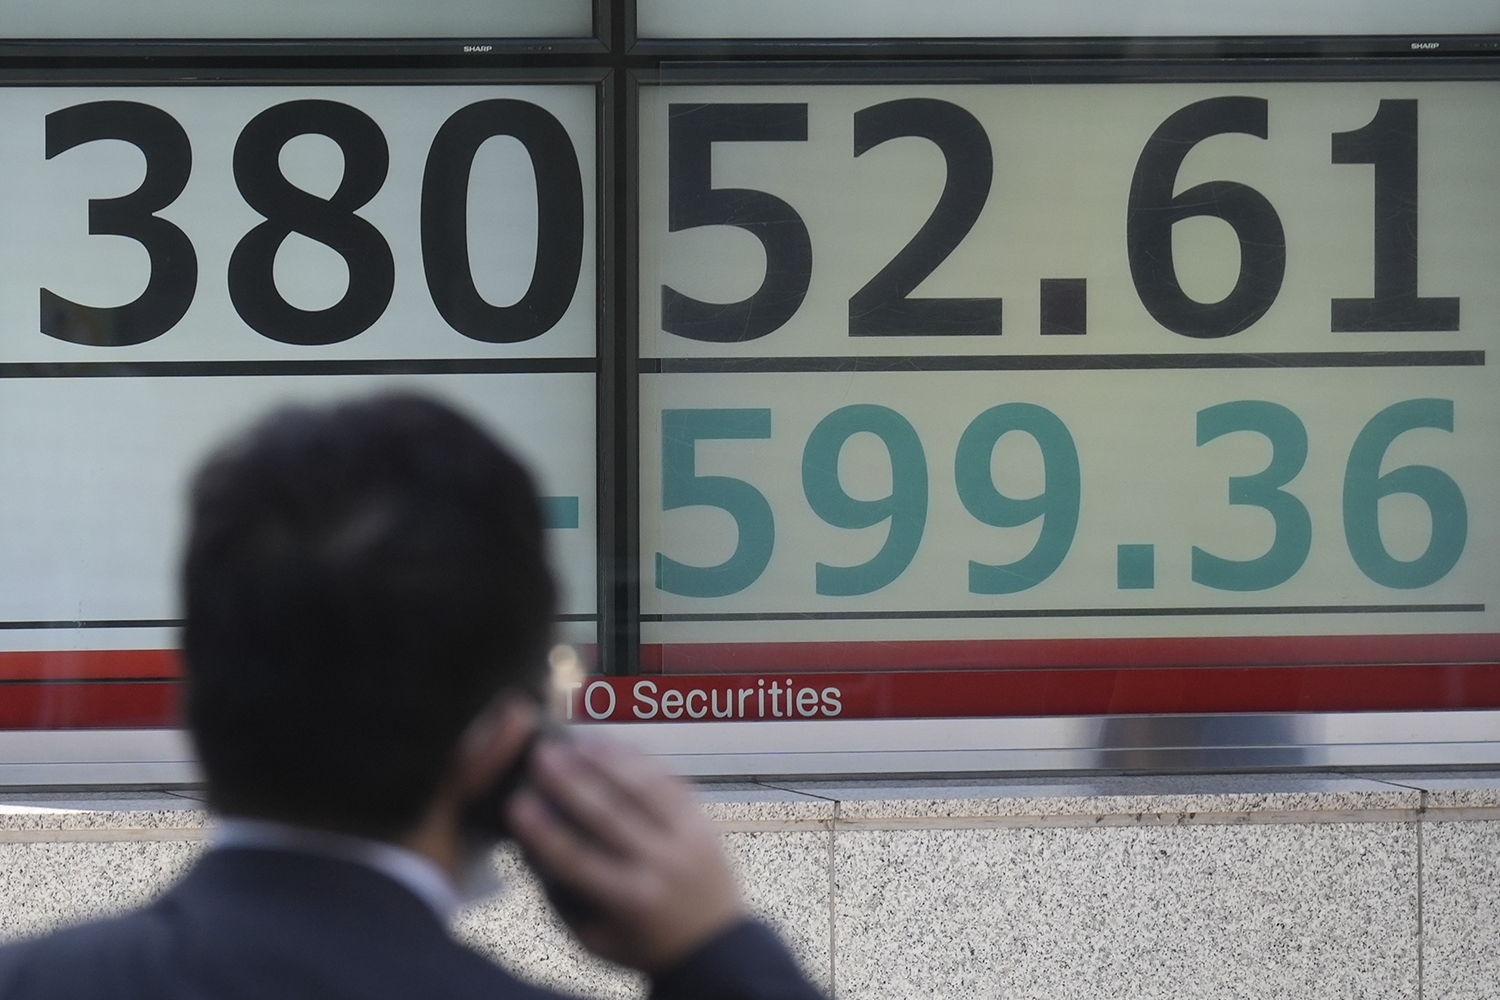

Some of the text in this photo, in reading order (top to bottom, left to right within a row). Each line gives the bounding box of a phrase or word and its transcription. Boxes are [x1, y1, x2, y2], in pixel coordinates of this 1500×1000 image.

[463, 45, 493, 53] SHARP
[1411, 42, 1440, 50] SHARP
[632, 678, 842, 719] Securities
